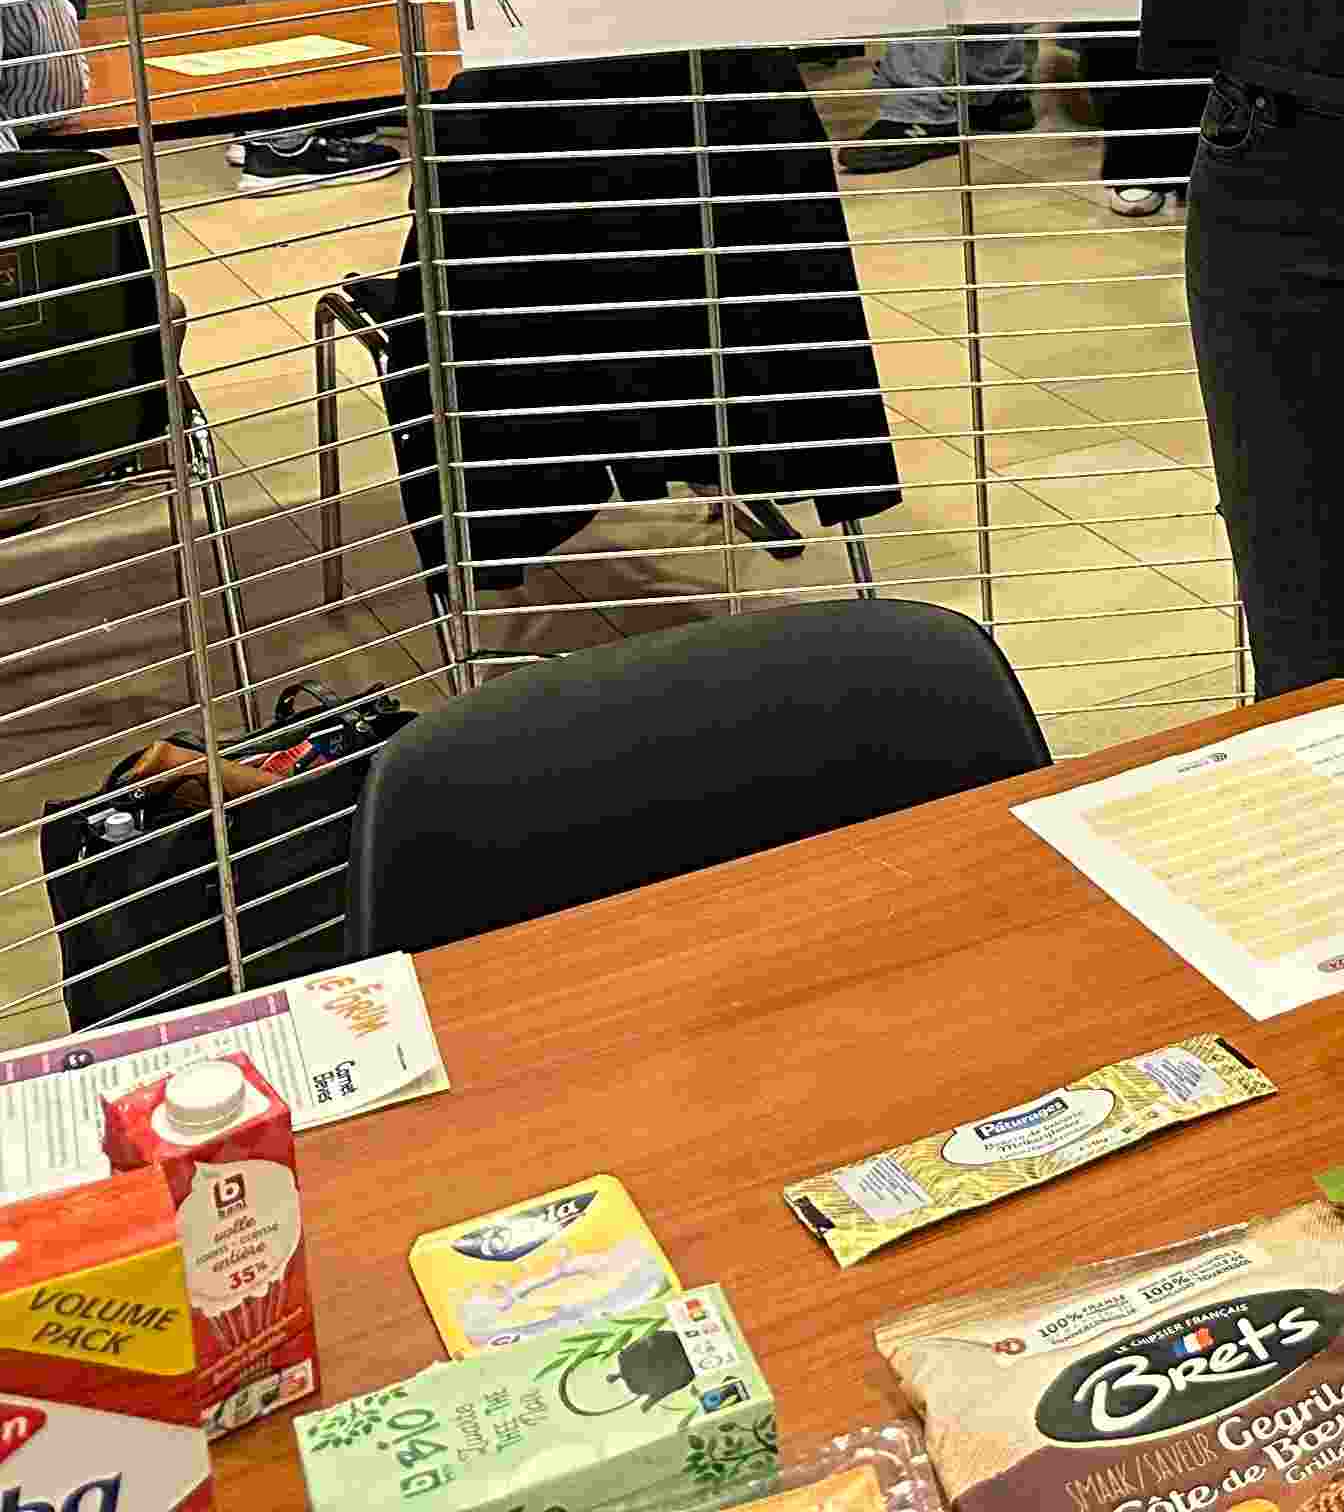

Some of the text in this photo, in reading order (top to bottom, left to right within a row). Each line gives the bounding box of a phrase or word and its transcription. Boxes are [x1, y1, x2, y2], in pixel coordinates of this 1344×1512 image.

[1141, 1274, 1193, 1301] 100%
[28, 1287, 181, 1332] VOLUME
[1038, 1309, 1084, 1339] 100%
[1186, 1303, 1249, 1325] FRANÇAIS
[31, 1321, 133, 1355] PACK
[1074, 1306, 1320, 1432] Brets
[1222, 1462, 1267, 1492] de
